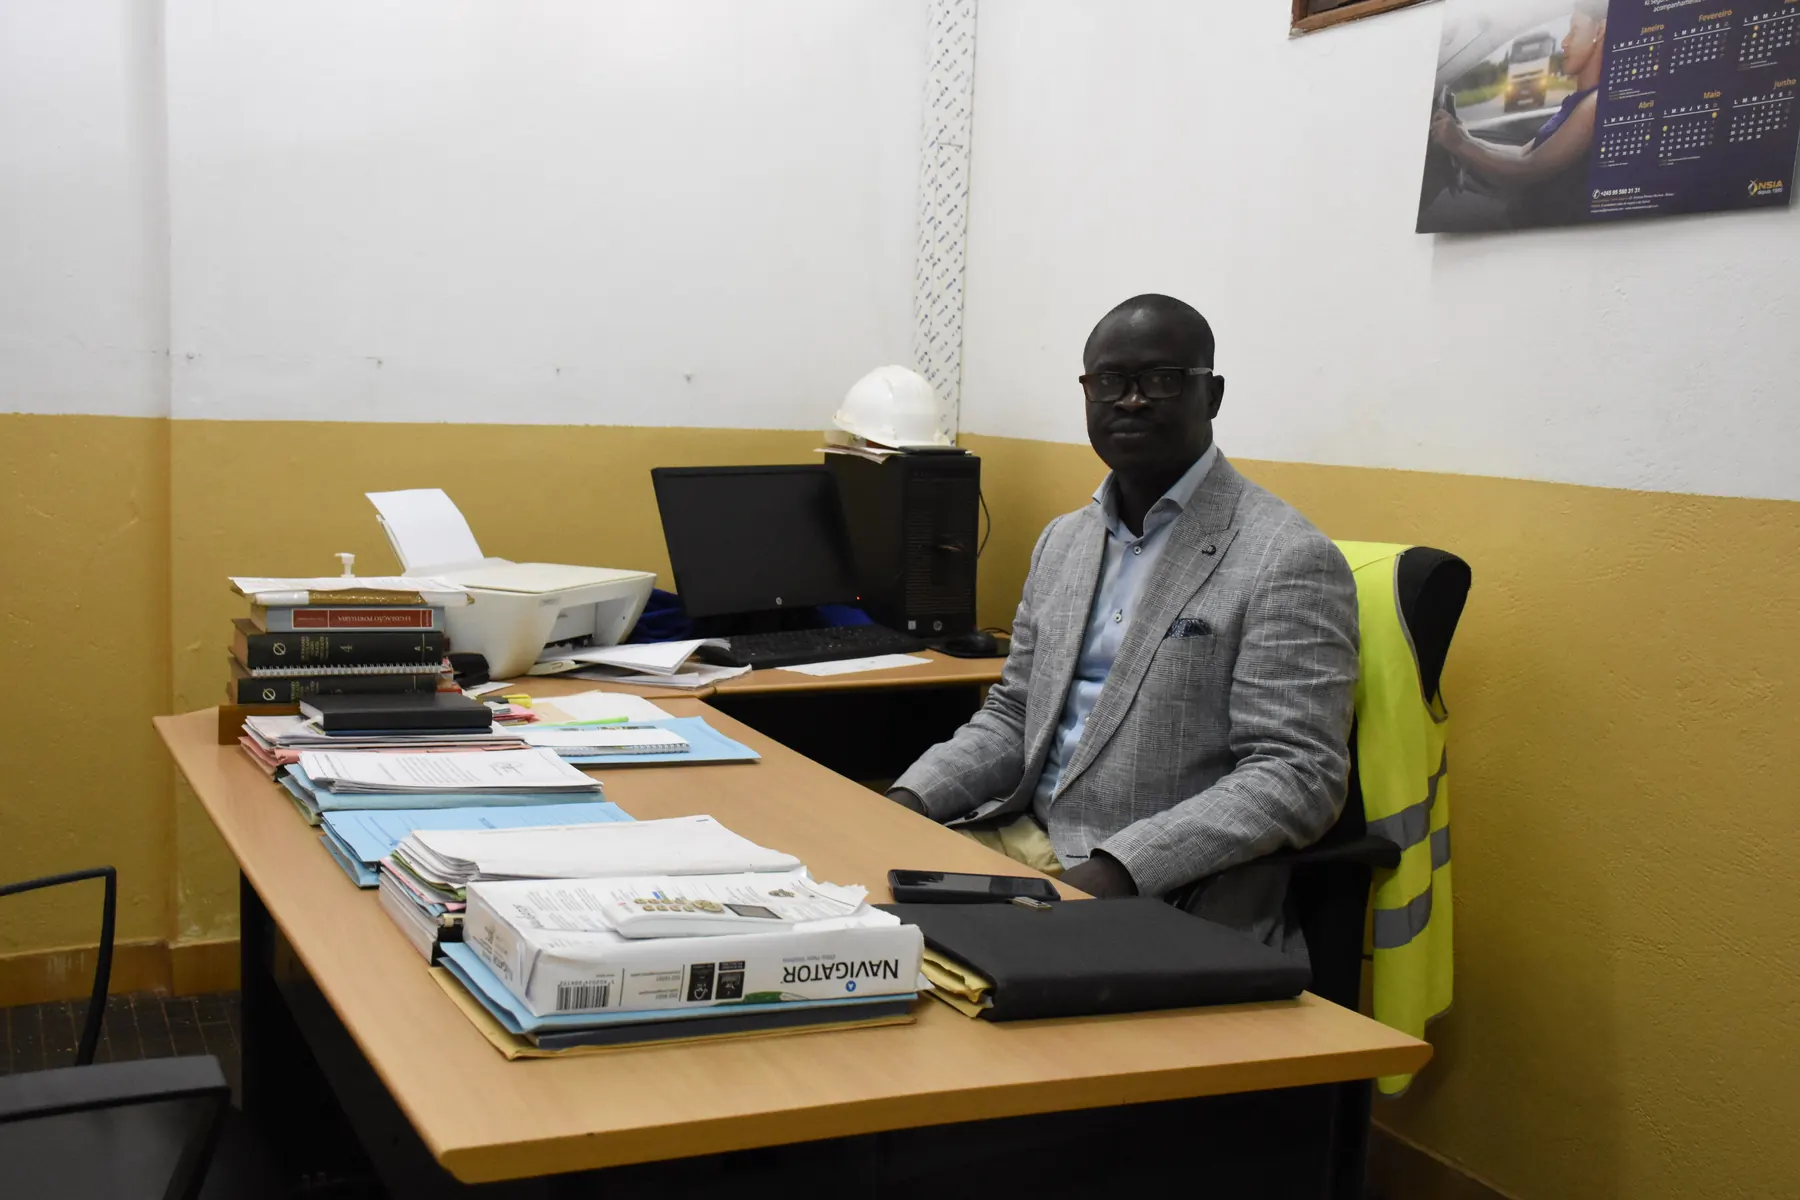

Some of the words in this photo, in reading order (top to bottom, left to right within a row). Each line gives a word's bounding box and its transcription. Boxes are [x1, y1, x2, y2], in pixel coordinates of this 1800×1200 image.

[1699, 9, 1733, 22] Fevereiro
[1640, 24, 1665, 35] Janeiro
[1773, 78, 1797, 90] Junho
[1703, 90, 1721, 99] Maio
[1638, 100, 1655, 109] Abril
[1758, 180, 1784, 190] NSIA
[782, 959, 899, 984] NAVIGATOR
